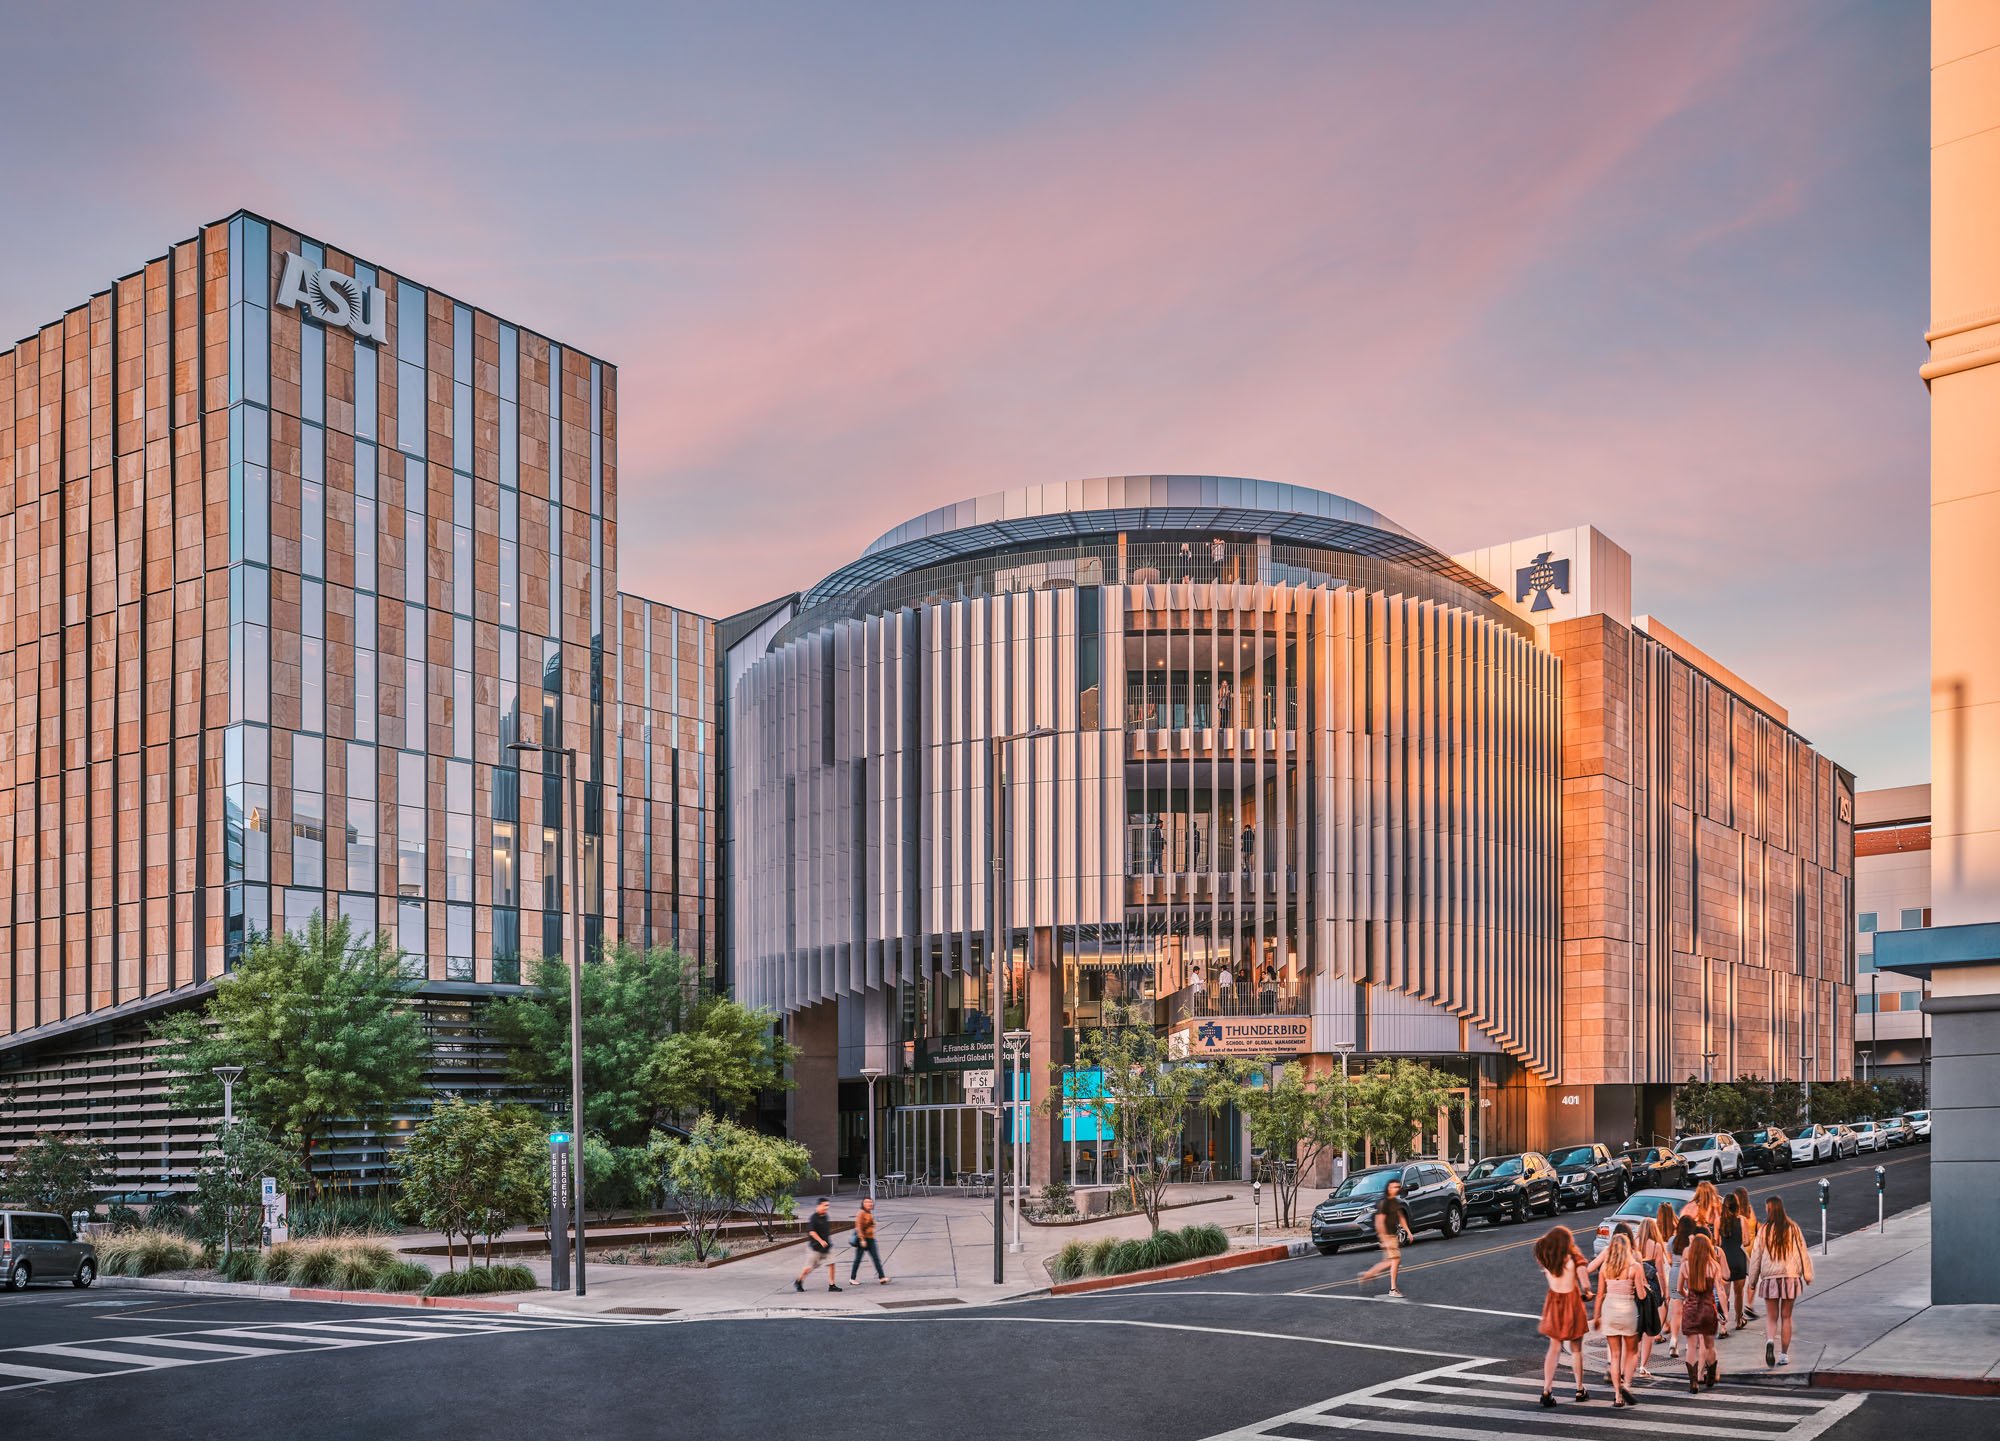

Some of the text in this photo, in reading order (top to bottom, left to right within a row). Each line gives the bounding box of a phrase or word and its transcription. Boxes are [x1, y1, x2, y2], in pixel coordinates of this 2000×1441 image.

[276, 251, 389, 345] ASU
[1225, 1025, 1307, 1036] THUNDERBIRD
[949, 1043, 969, 1052] Francis
[977, 1041, 995, 1050] Dionn
[933, 1054, 966, 1064] Thunderbird
[967, 1052, 987, 1062] Global
[979, 1077, 988, 1087] St
[971, 1094, 986, 1104] Polk
[1561, 1095, 1580, 1105] 401
